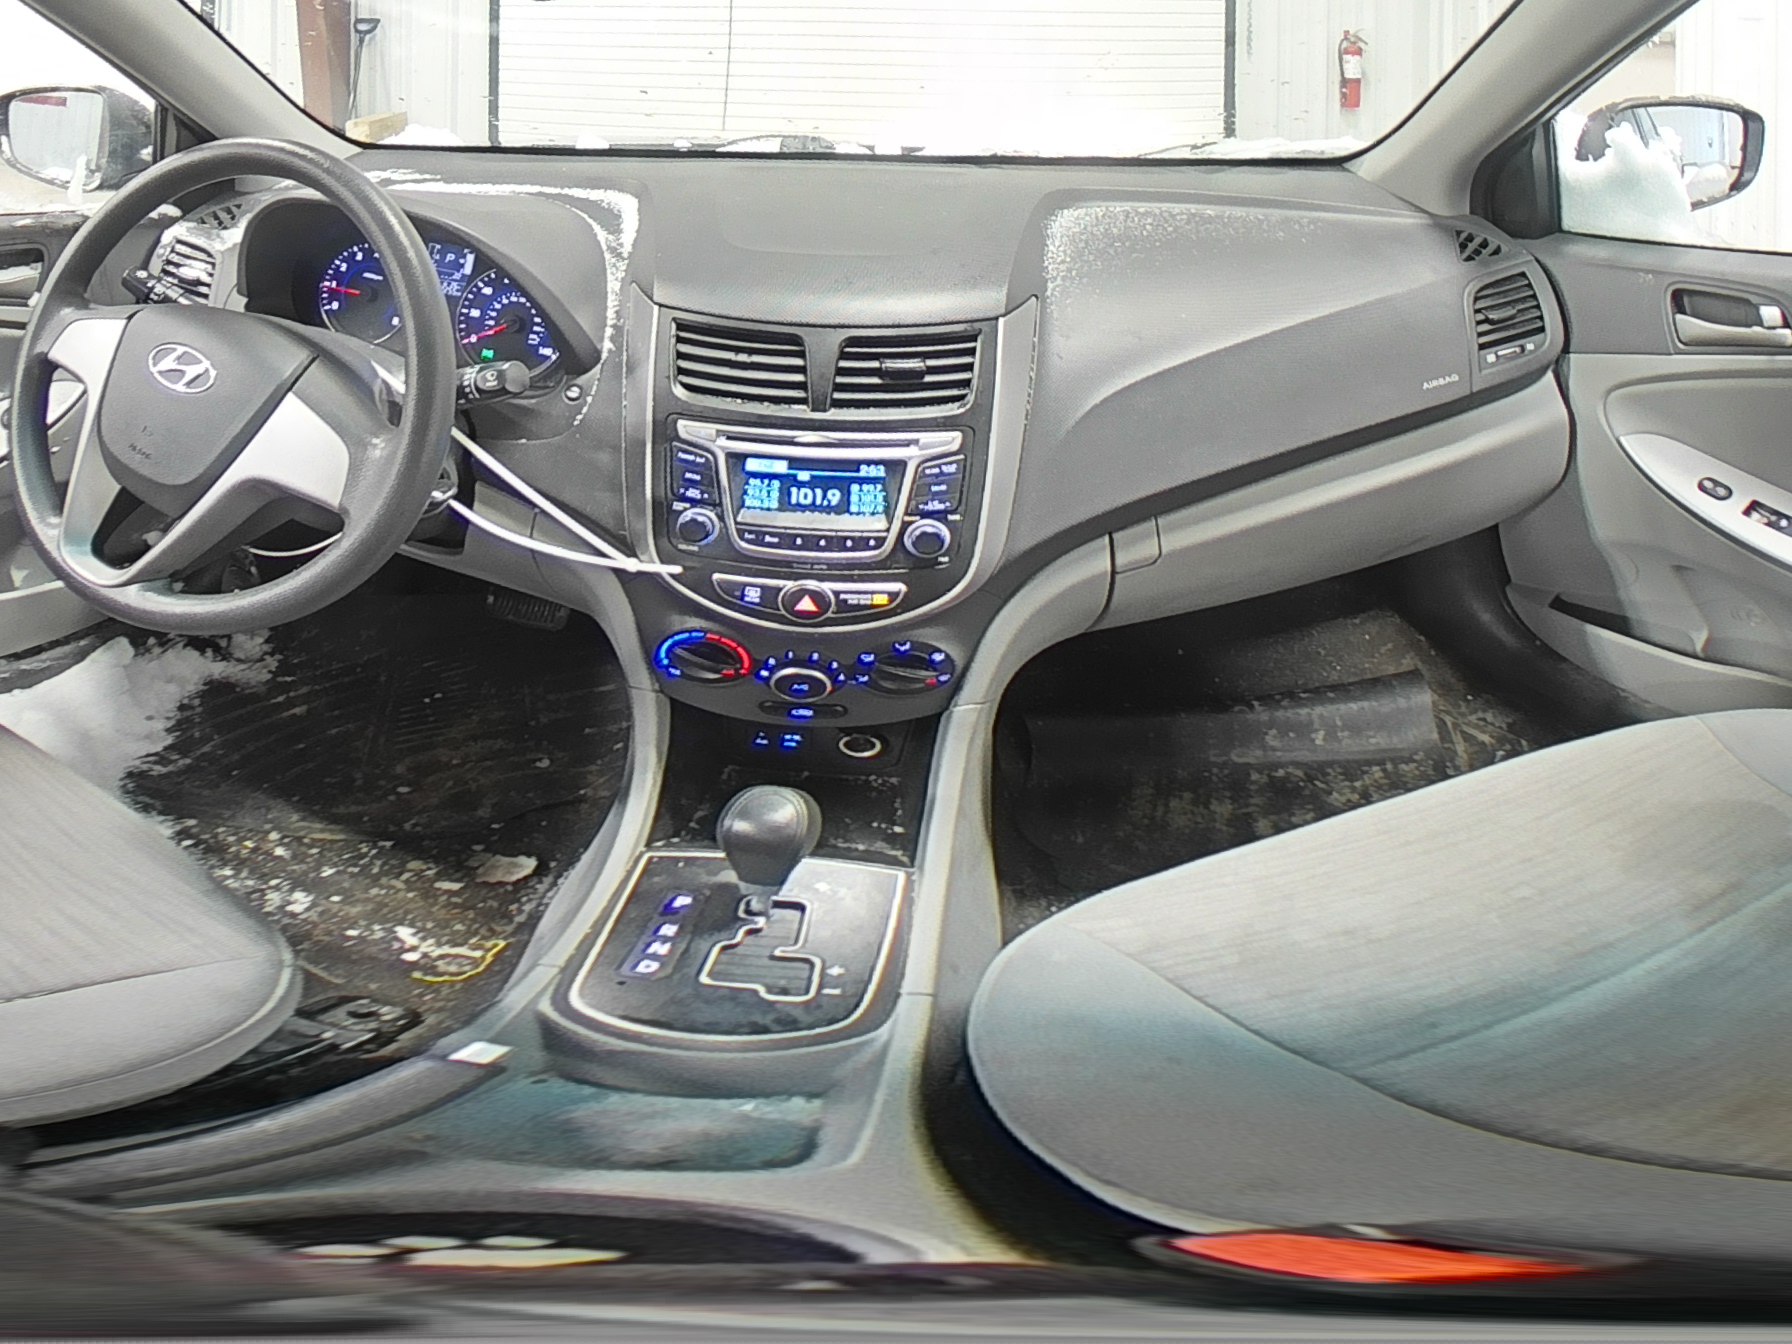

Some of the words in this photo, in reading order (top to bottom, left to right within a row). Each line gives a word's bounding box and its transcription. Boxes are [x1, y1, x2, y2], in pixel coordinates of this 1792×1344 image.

[445, 253, 456, 263] P
[1422, 373, 1459, 391] AIRBAG
[790, 486, 841, 506] 101.9
[644, 940, 672, 955] N
[634, 959, 661, 973] D
